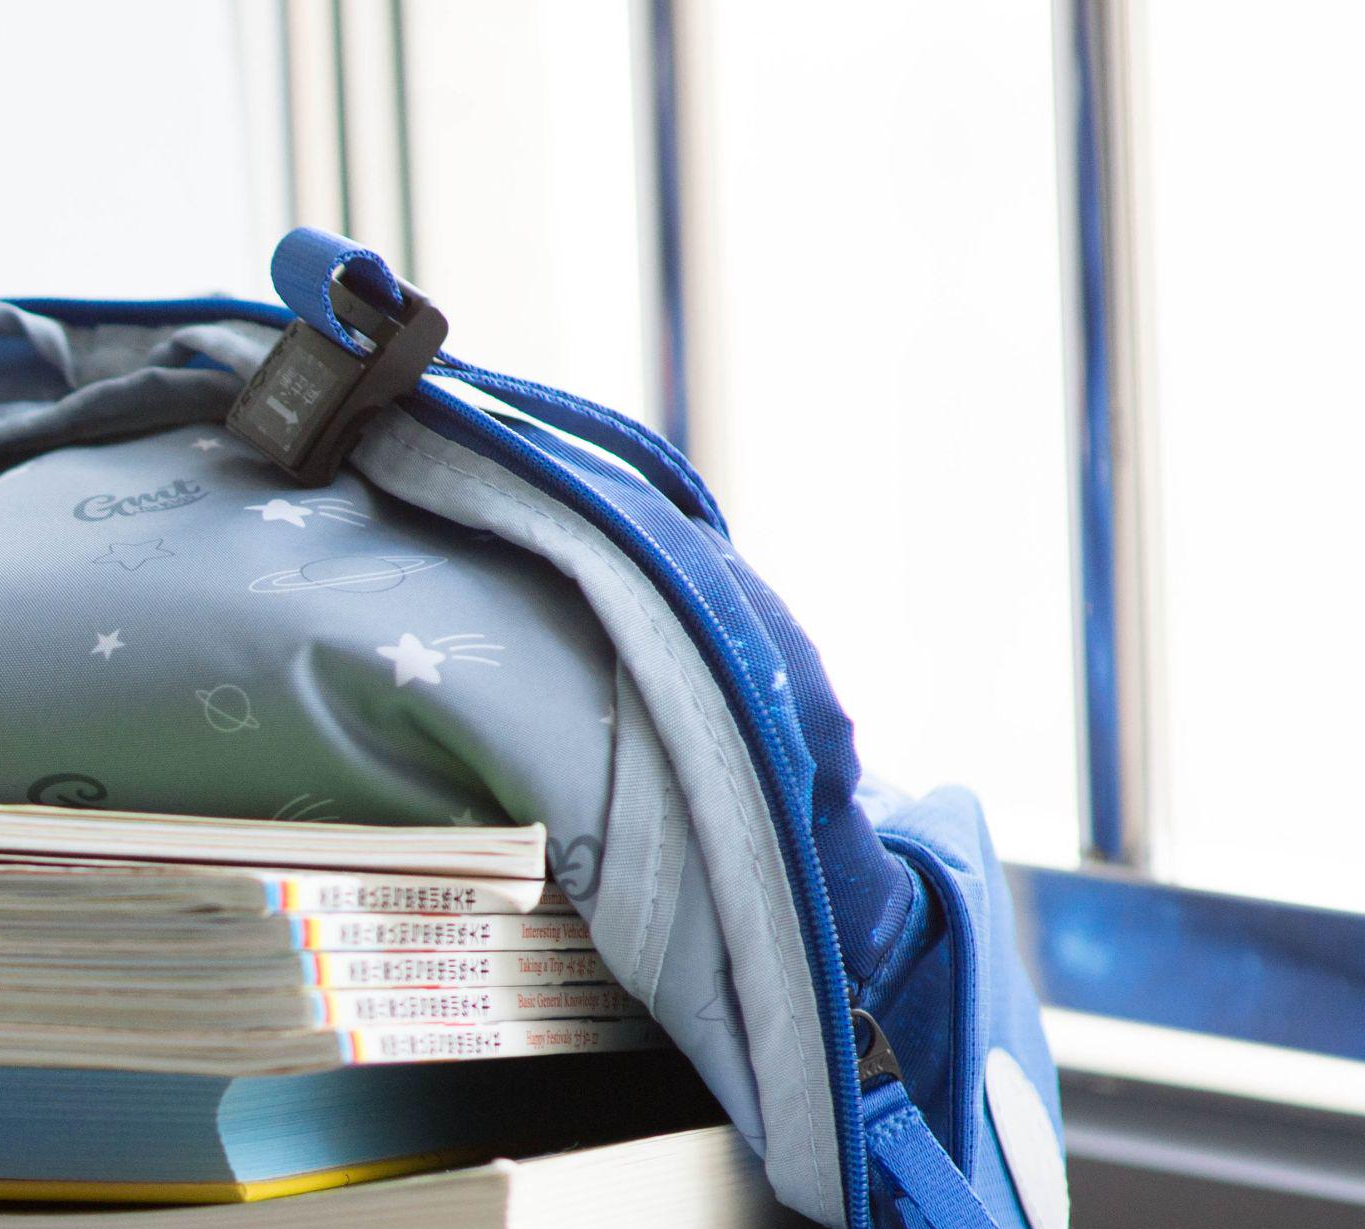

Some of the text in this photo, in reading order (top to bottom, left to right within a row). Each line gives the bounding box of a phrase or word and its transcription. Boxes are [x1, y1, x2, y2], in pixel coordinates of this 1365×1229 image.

[521, 922, 589, 942] Interesting Vehicle
[518, 957, 542, 976] Taking
[549, 957, 564, 976] Trip
[517, 993, 536, 1009] Basic
[537, 992, 563, 1008] General
